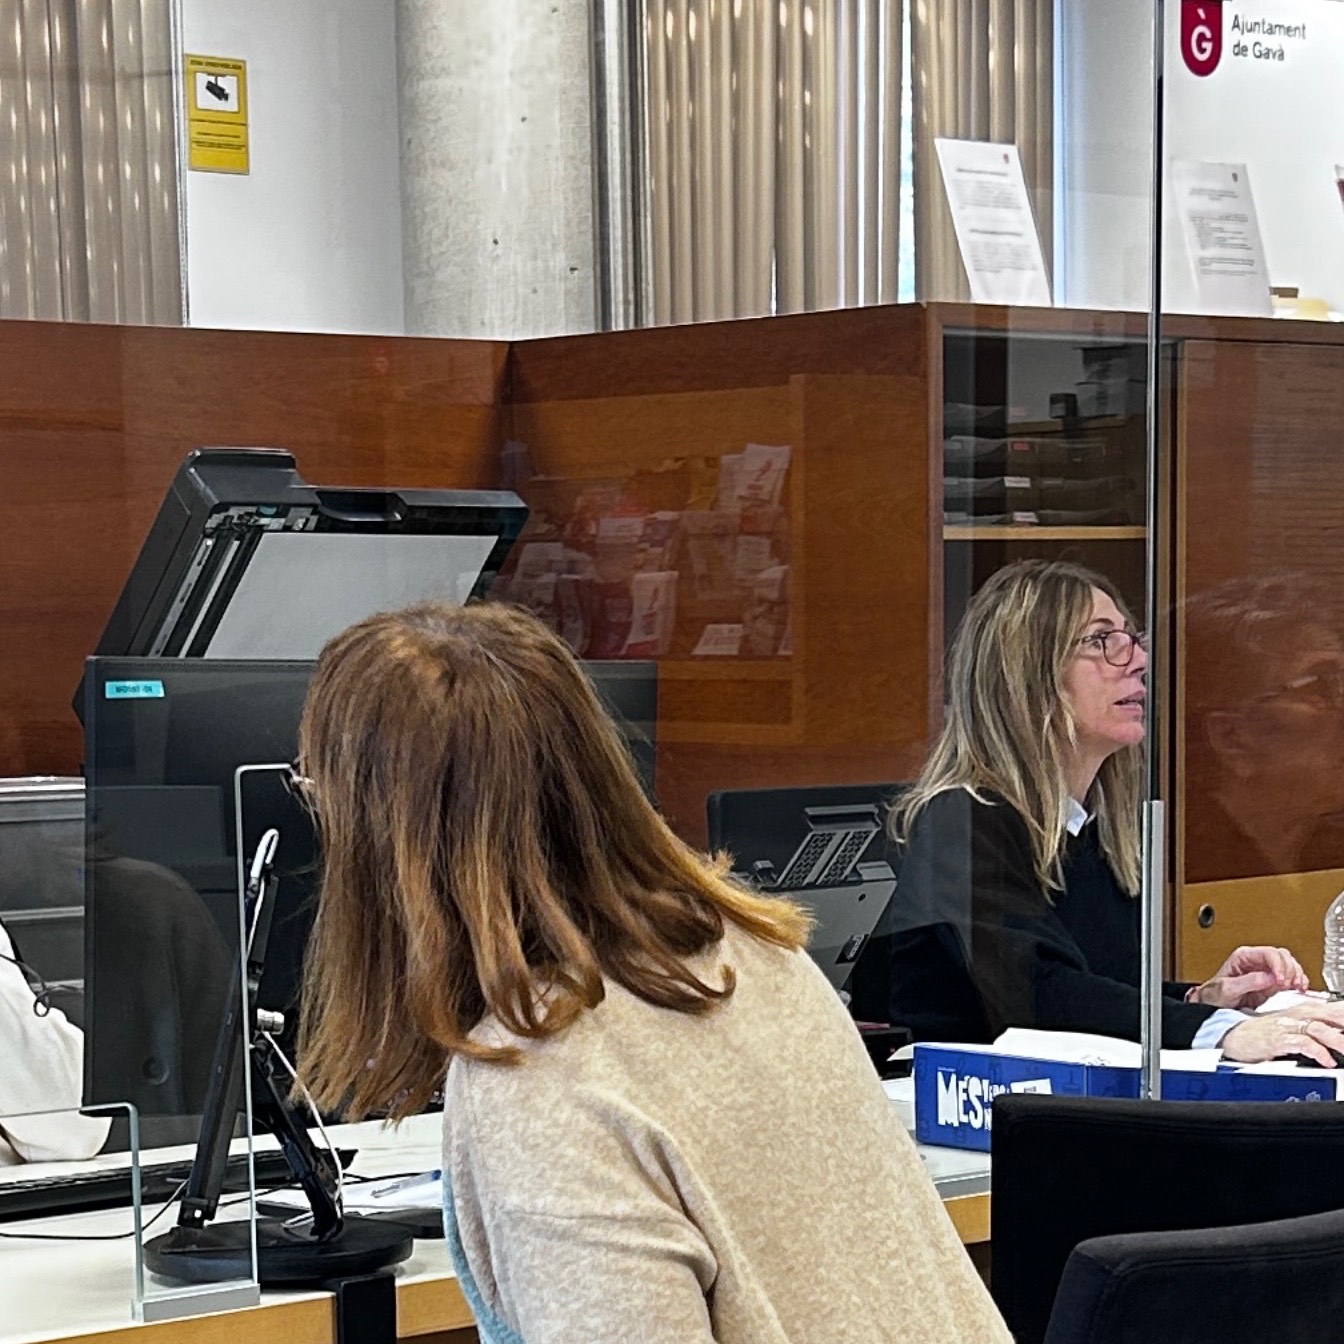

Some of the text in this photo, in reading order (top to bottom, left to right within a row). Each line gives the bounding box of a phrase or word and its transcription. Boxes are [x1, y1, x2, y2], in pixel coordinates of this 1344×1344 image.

[1231, 14, 1306, 39] Ajuntament
[1232, 41, 1285, 61] de Gavà
